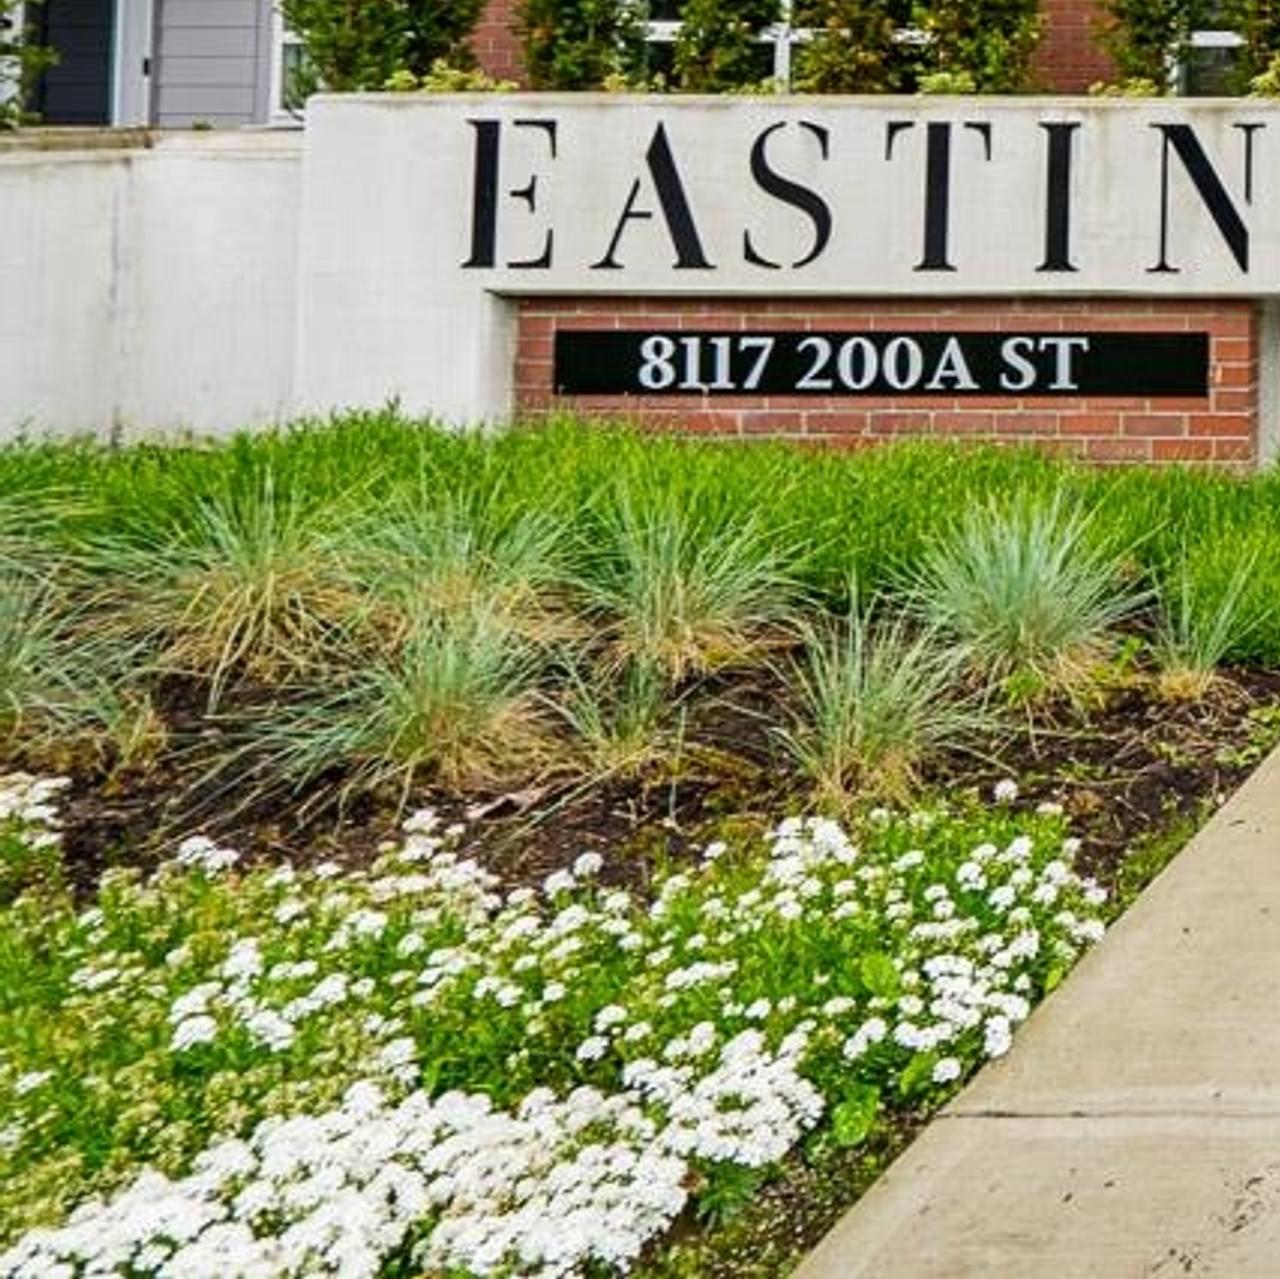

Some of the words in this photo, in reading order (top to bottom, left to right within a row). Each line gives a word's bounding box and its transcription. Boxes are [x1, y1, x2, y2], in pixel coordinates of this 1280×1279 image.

[460, 119, 1267, 275] EASTIN
[638, 335, 775, 392] 8117
[795, 335, 980, 391] 200A
[1000, 335, 1090, 391] ST
